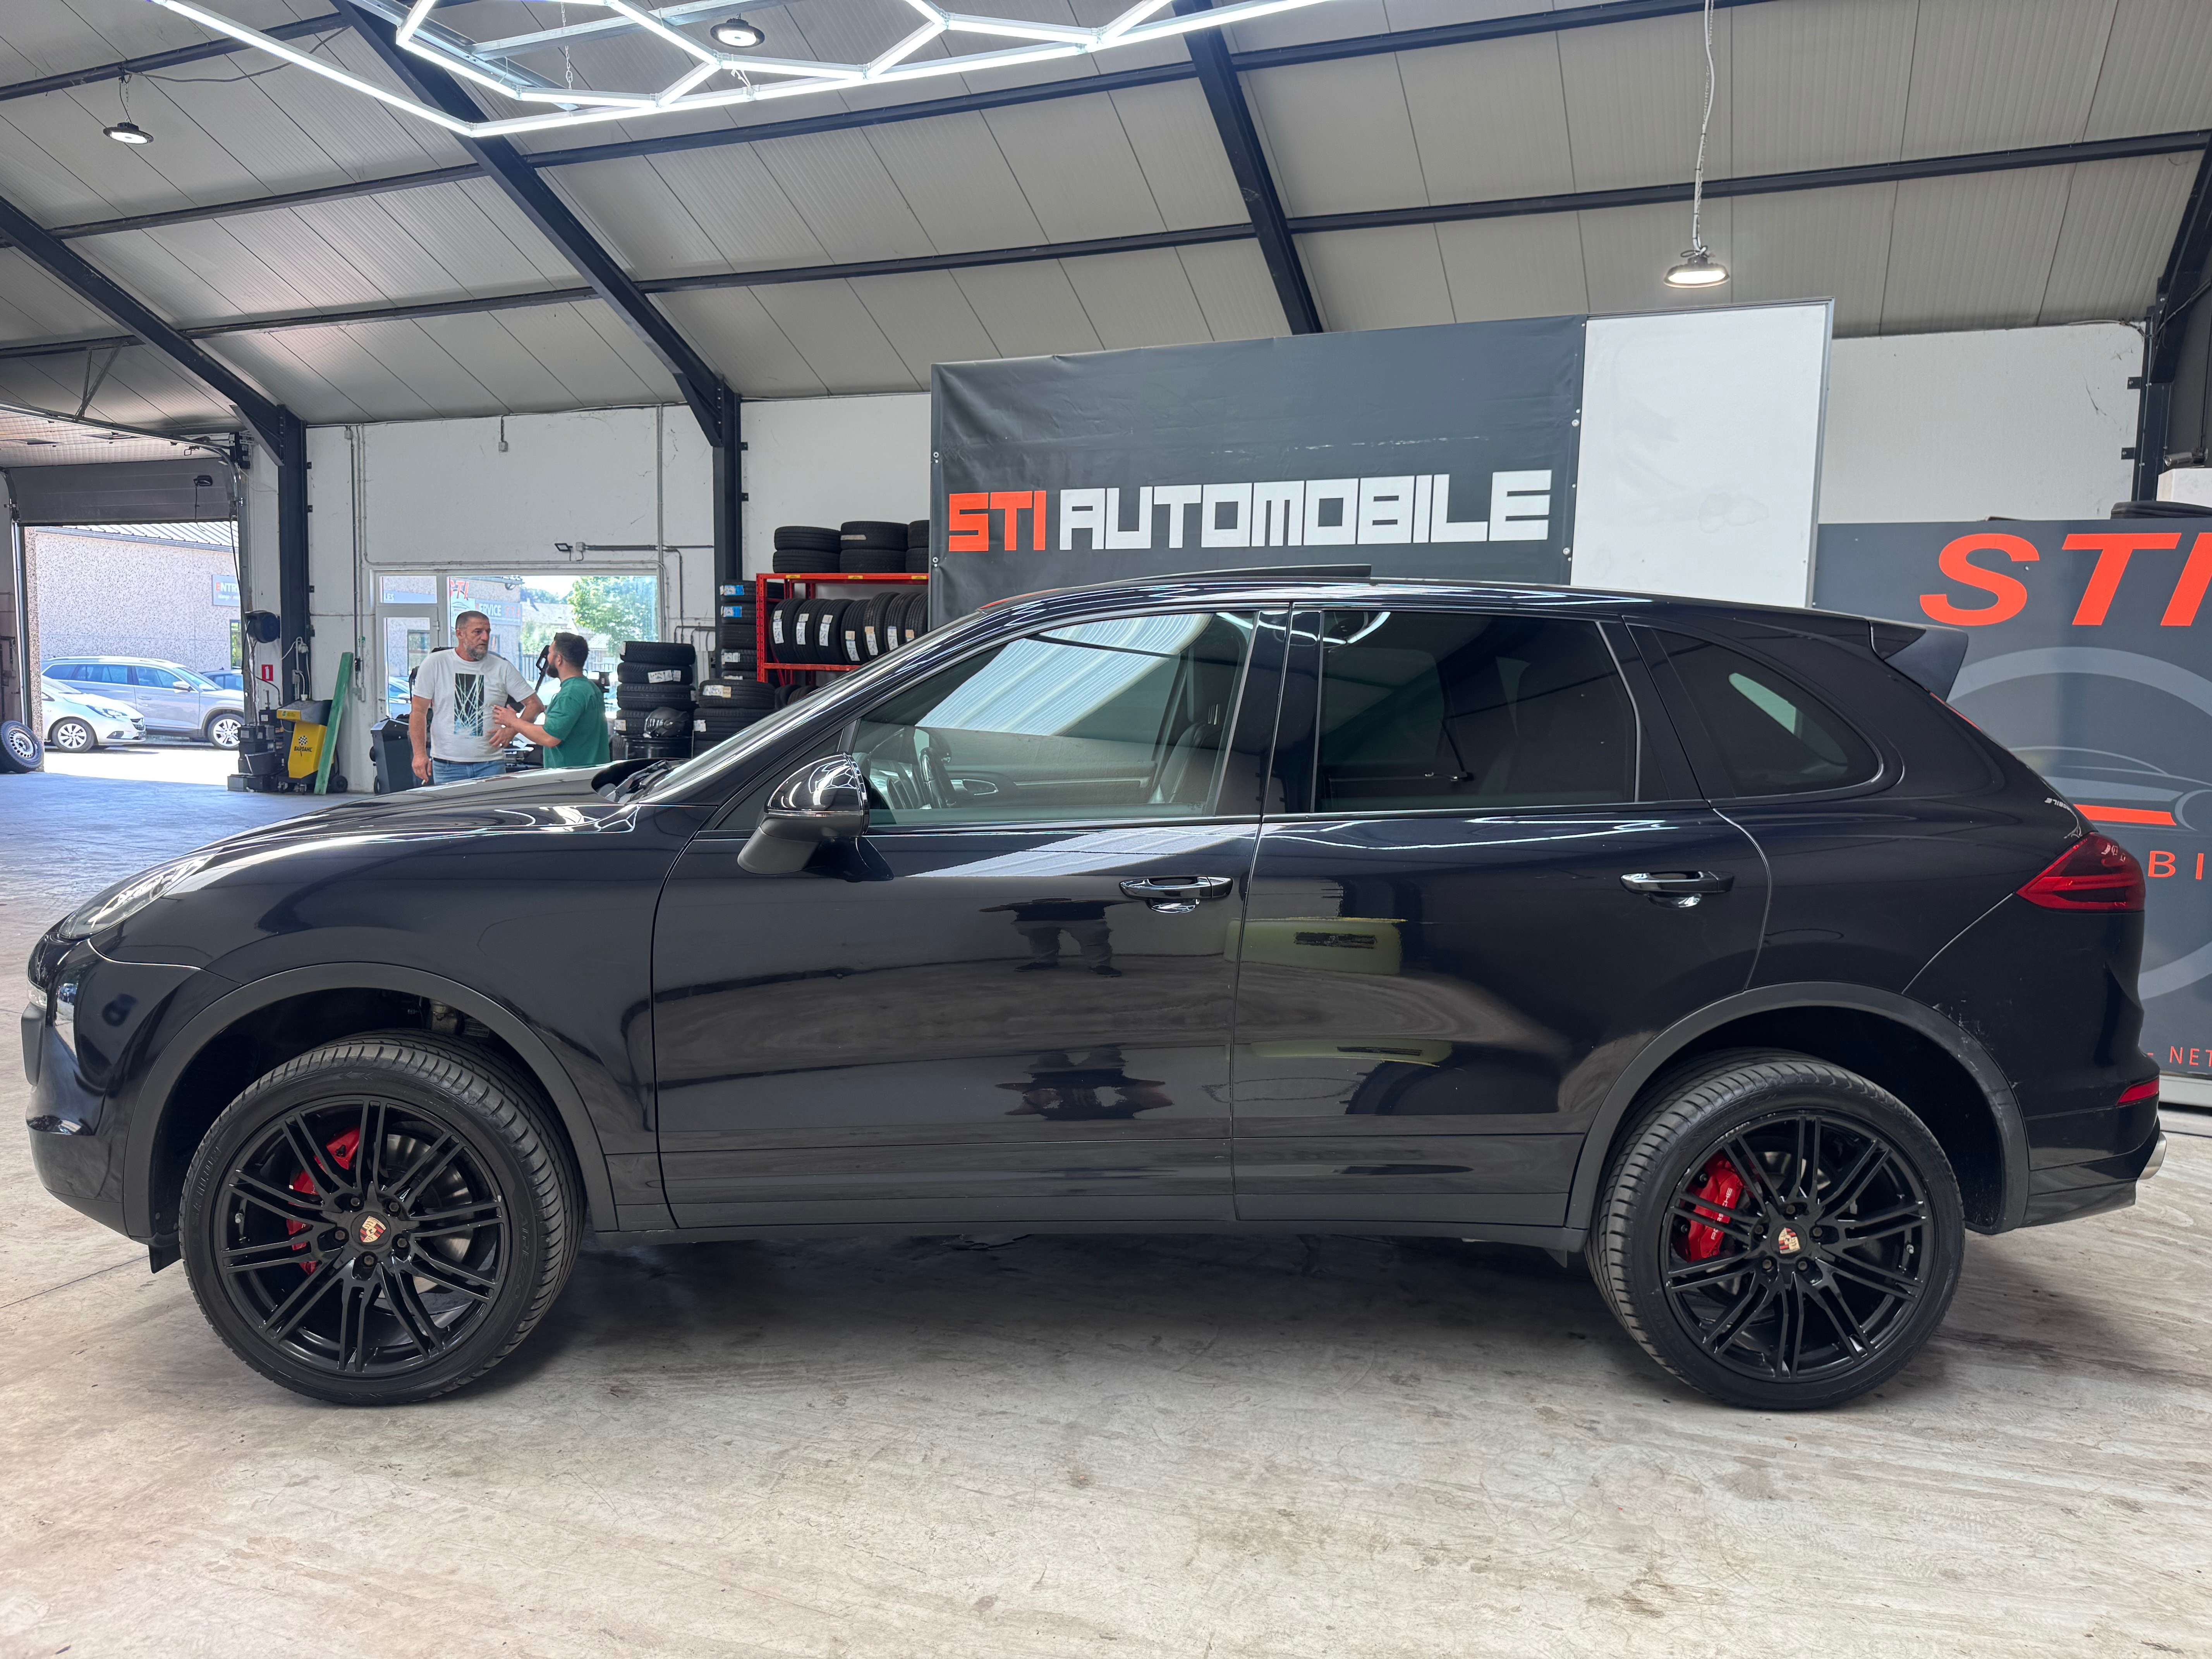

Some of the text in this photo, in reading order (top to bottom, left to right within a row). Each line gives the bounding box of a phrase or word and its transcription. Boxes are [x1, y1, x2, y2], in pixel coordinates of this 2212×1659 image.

[948, 470, 1552, 552] STI AUTOMOBILE
[1920, 532, 2212, 627] STI
